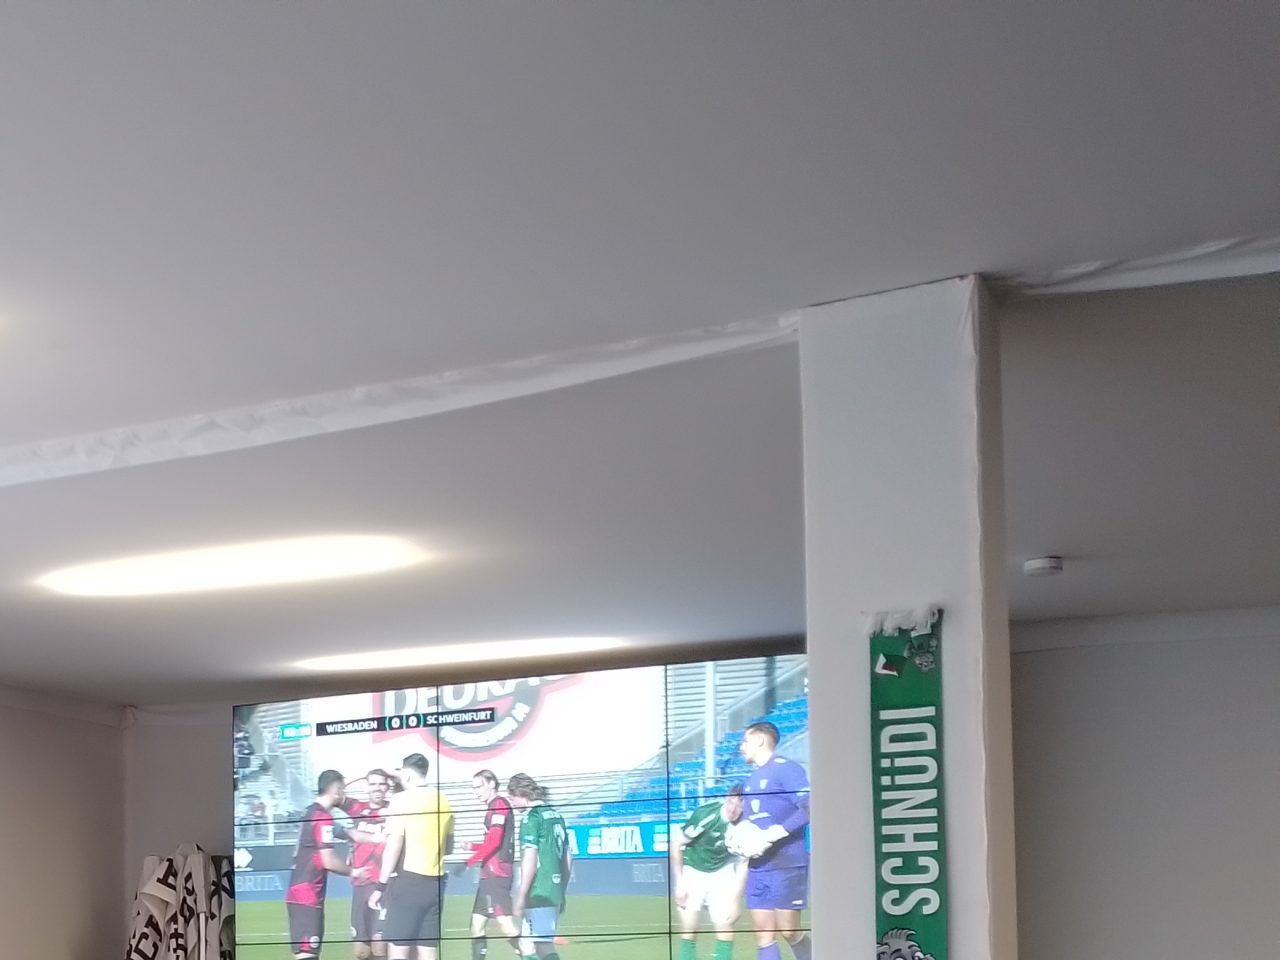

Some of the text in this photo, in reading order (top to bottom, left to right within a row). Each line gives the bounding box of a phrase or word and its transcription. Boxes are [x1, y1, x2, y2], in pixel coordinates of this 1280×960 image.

[325, 720, 378, 733] WIESBADEN
[426, 711, 492, 725] SCHWEINFURT
[879, 706, 940, 916] SCHNÜDI
[600, 826, 643, 853] BRITA
